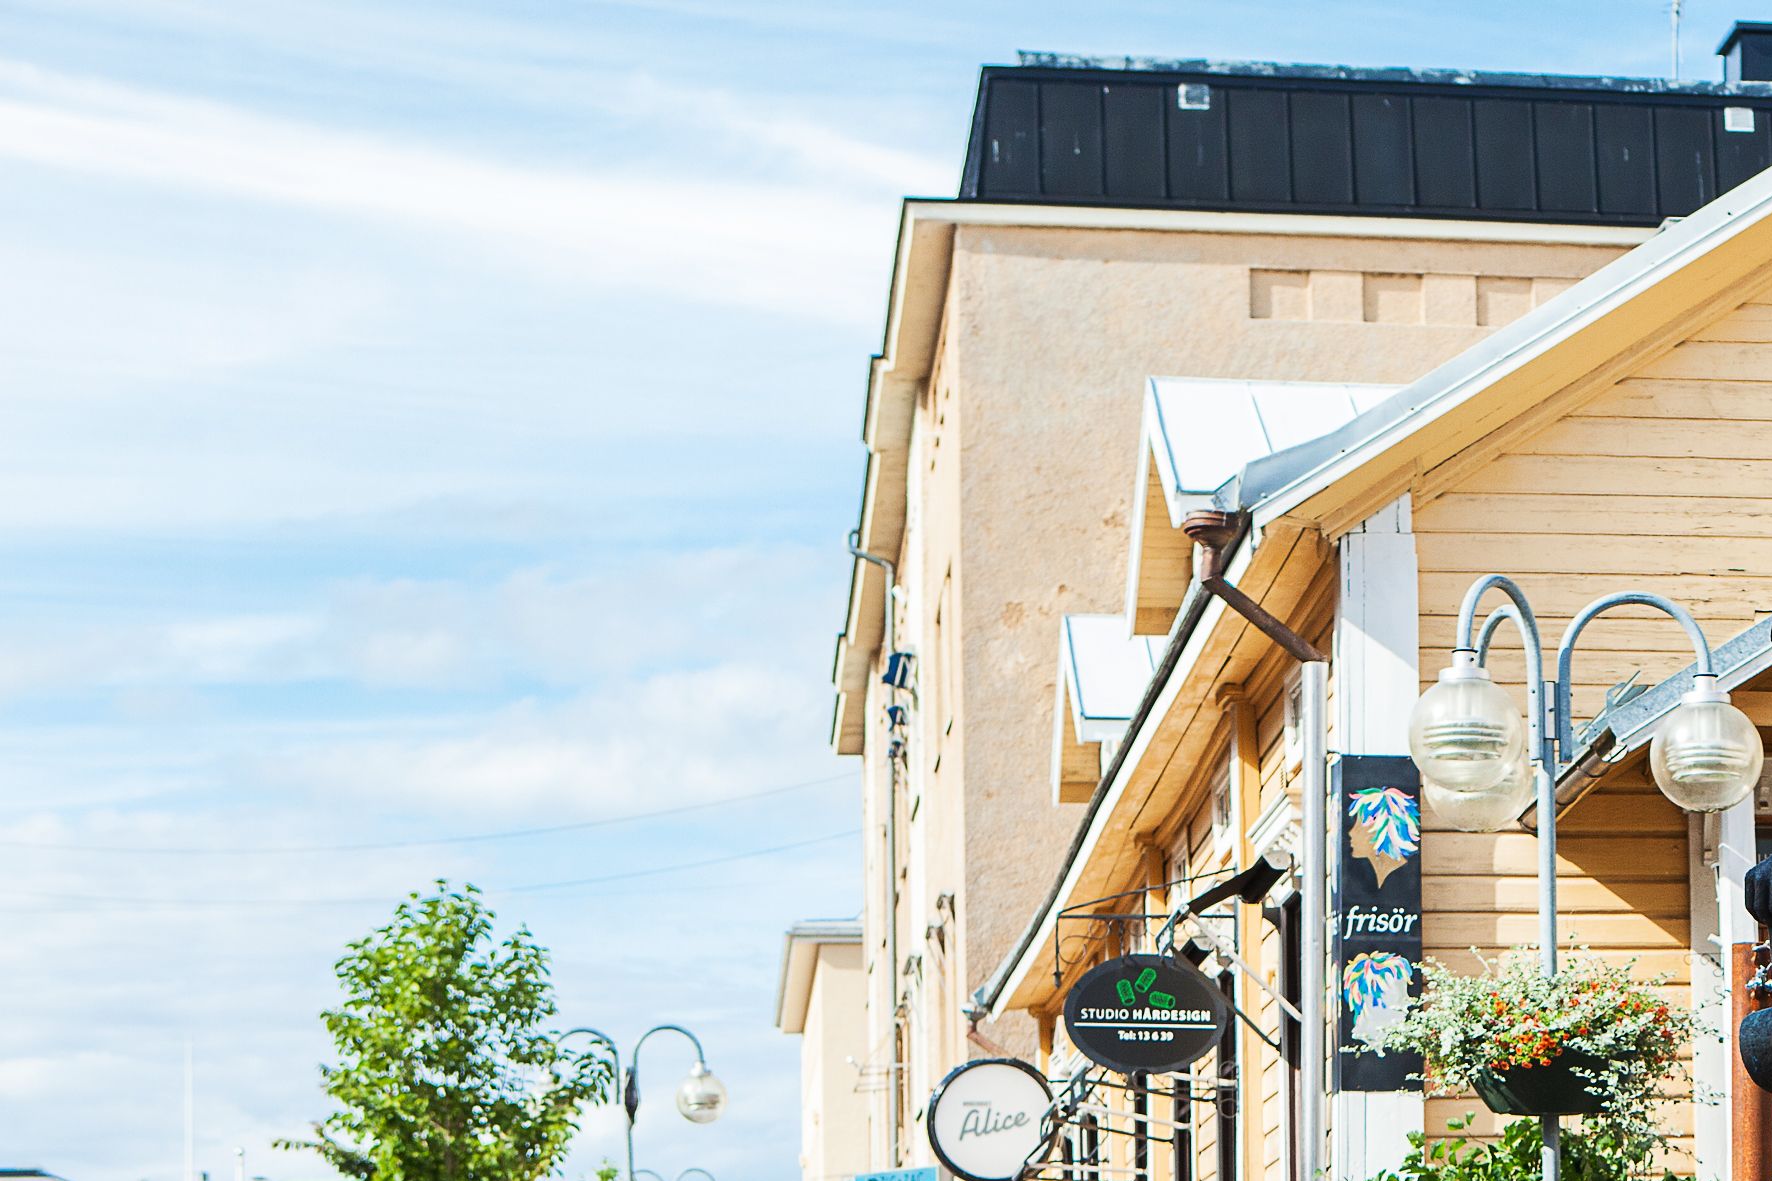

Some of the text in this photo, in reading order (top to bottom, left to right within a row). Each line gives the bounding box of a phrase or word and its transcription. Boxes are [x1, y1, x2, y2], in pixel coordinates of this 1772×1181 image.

[1343, 905, 1418, 940] frisör
[1080, 1007, 1211, 1022] STUDIO HÅRDESIGN
[959, 1108, 1031, 1142] Alice
